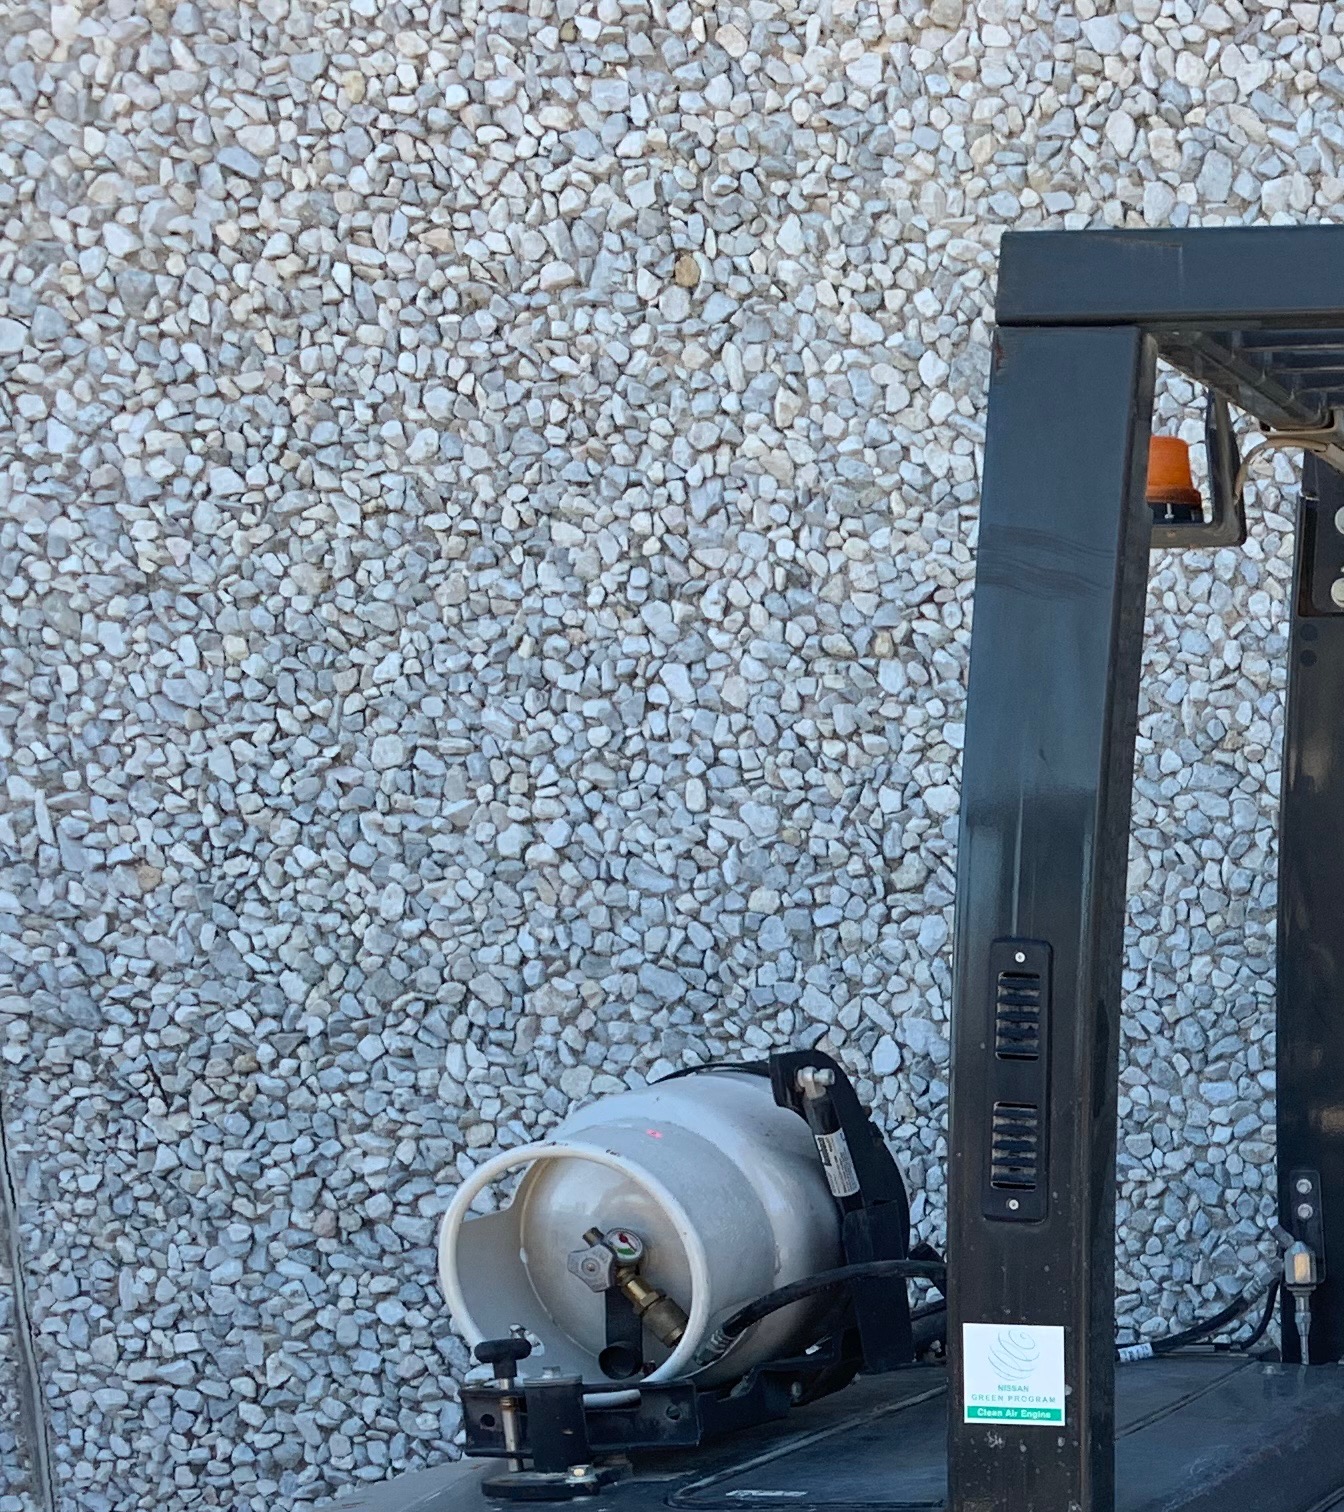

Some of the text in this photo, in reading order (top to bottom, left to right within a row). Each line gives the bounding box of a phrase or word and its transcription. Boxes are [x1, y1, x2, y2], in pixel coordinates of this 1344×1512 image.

[998, 1384, 1029, 1392] NISSAN
[972, 1394, 1004, 1402] GREEN
[978, 1409, 1051, 1420] Clean Air Engine
